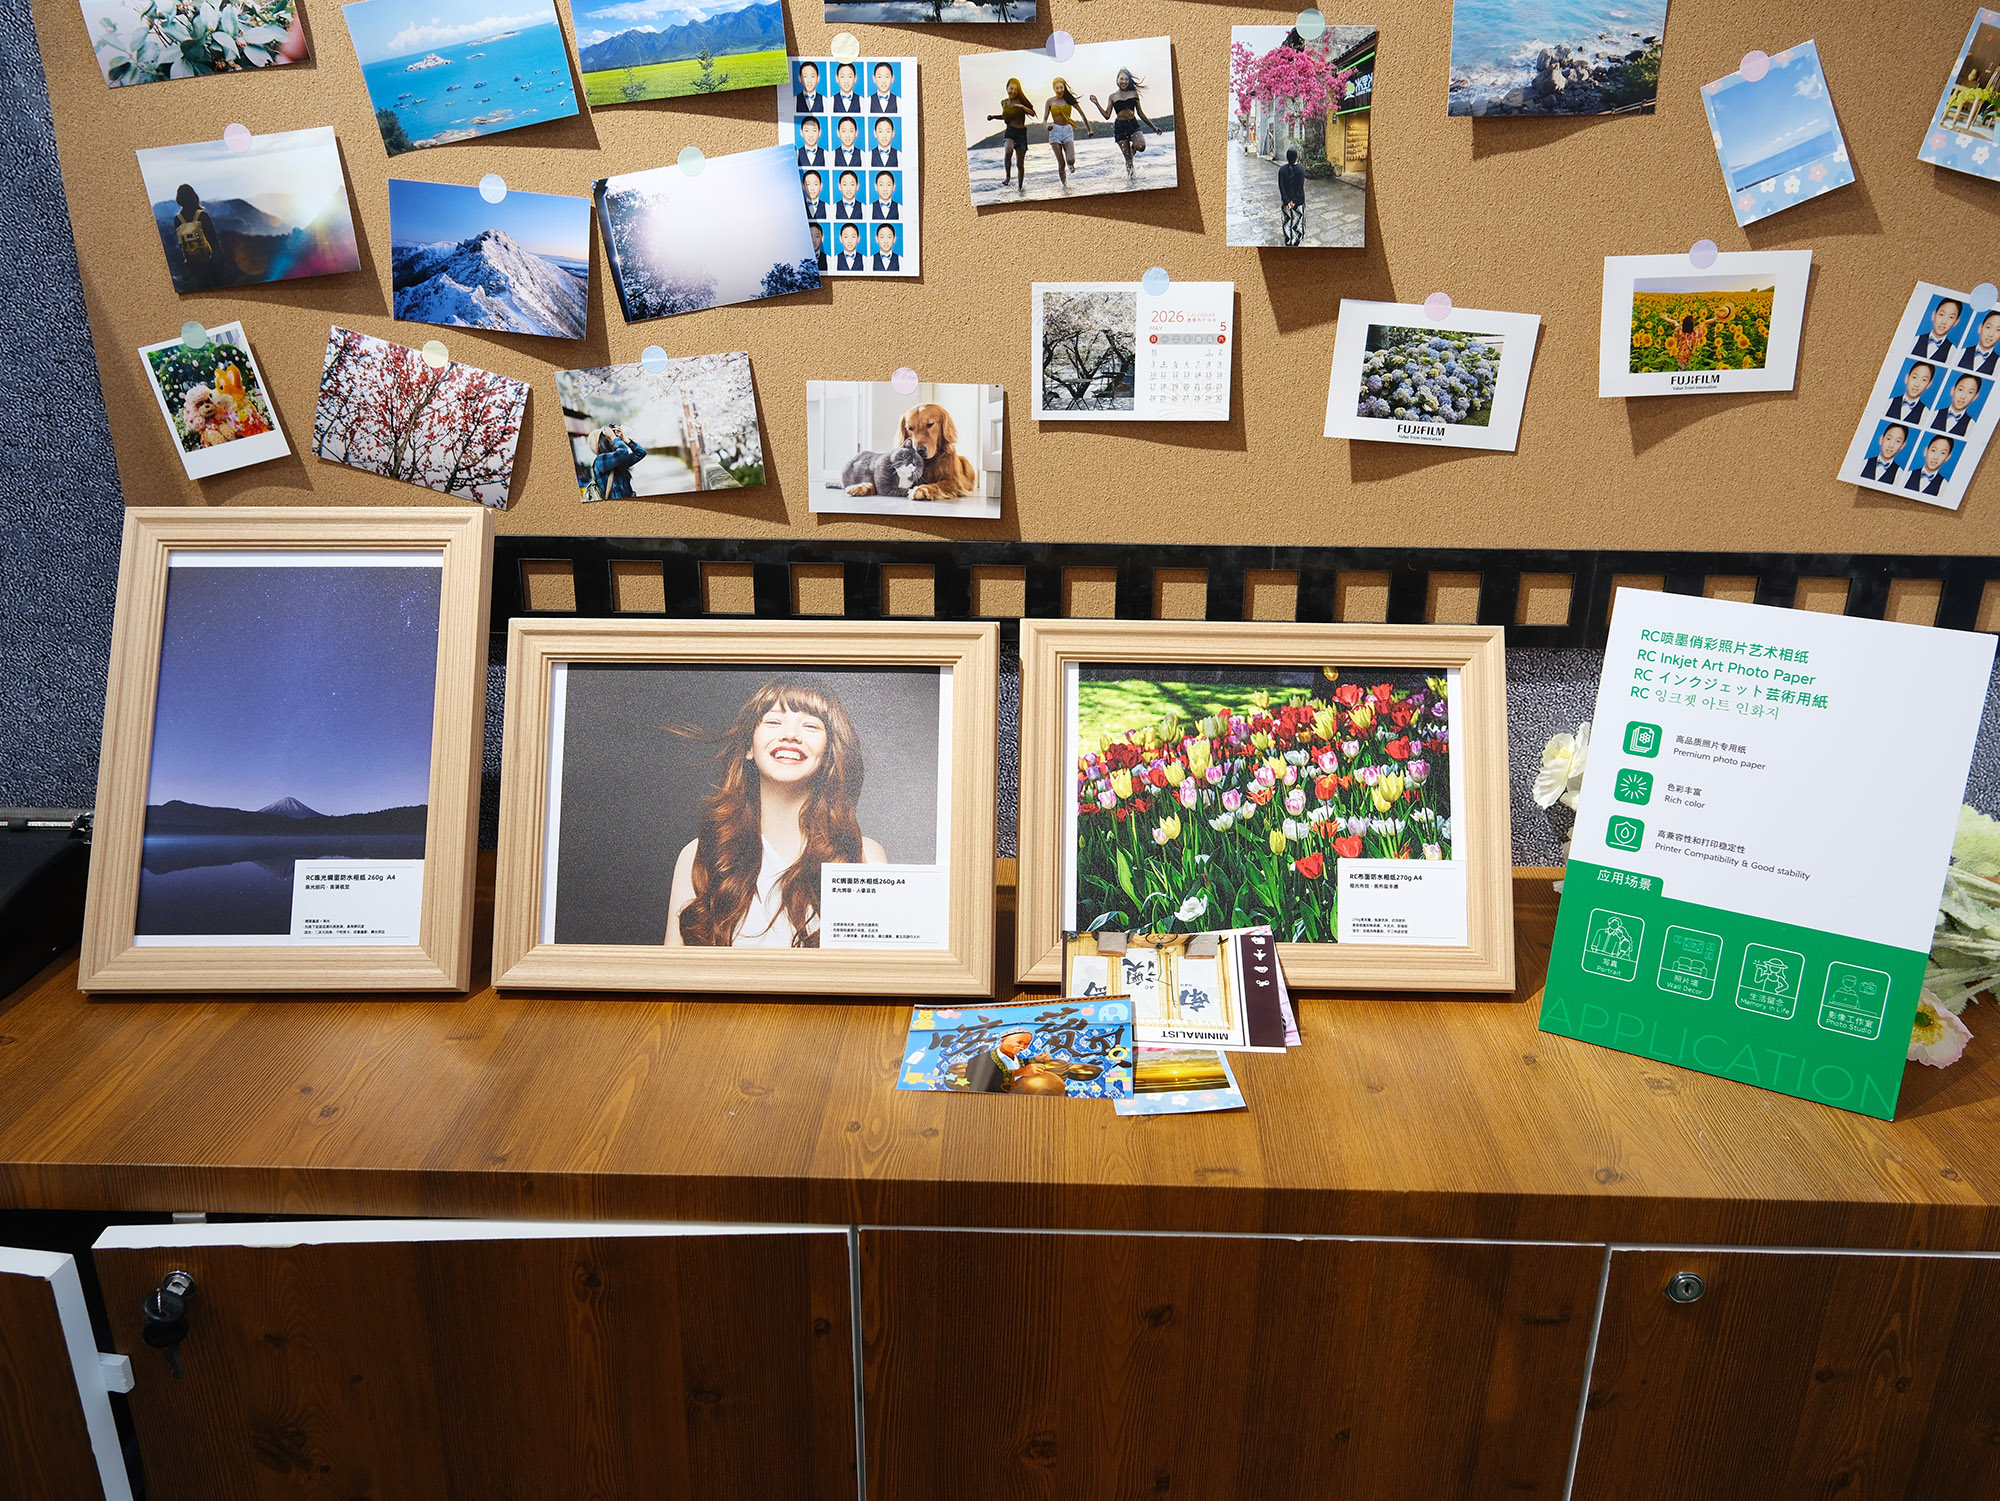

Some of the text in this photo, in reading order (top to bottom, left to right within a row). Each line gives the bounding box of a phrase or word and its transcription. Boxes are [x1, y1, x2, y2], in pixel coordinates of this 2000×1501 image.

[1151, 310, 1184, 323] 2026
[1220, 322, 1227, 331] 5
[1671, 374, 1720, 385] FUJIFILM
[1397, 424, 1445, 436] FUJIFILM
[1640, 629, 1809, 664] RC喷墨俏彩照片艺术相纸
[1637, 648, 1816, 686] RC Inkjet Art Photo Paper
[1633, 667, 1829, 710] RC インクジェット芸術用紙
[1630, 685, 1779, 721] RC 잉크젯 아트 인화지
[1675, 735, 1746, 754] 高品质照片专用纸
[1673, 747, 1766, 770] Premium photo paper
[1667, 783, 1702, 797] 色彩丰富
[1664, 794, 1705, 809] Rich color
[1657, 830, 1746, 854] 高兼容性和打印稳定性
[1654, 842, 1811, 881] Printer Compatibility & Good stability
[1597, 868, 1652, 891] 应用场景
[1596, 965, 1621, 976] Portrait
[1667, 982, 1703, 995] Wall Decor
[1179, 987, 1210, 1013] 南
[1738, 997, 1767, 1010] Memory
[1776, 1005, 1790, 1017] Life
[1749, 992, 1784, 1007] 生活留念
[1825, 1018, 1872, 1035] Photo Studio
[1828, 1010, 1874, 1029] 影像工作室
[1160, 1030, 1229, 1041] MINIMALIST
[1542, 997, 1901, 1113] APPLICATION
